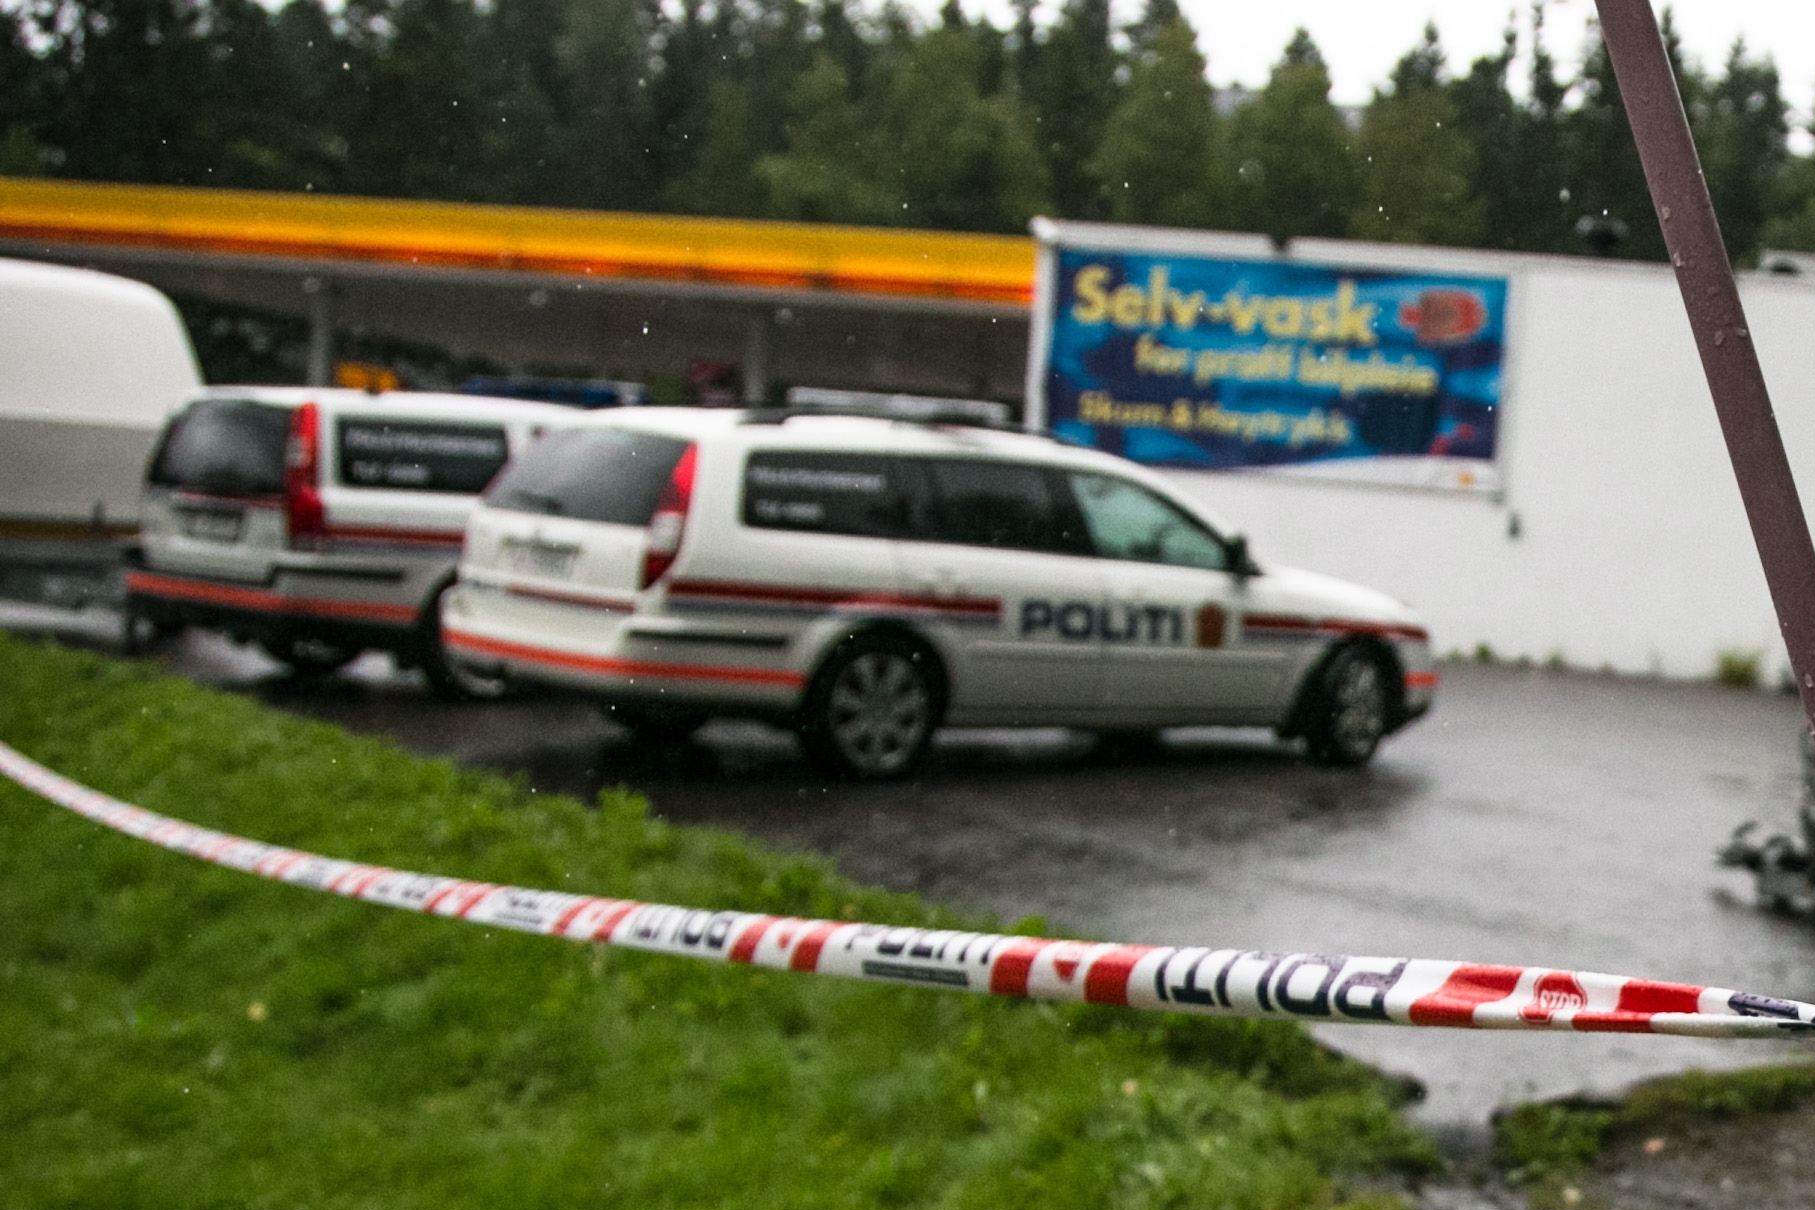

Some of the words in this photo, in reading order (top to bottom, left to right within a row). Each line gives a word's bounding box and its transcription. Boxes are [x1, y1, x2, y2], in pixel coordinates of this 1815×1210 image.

[1073, 264, 1377, 344] Selv-vask
[1135, 333, 1186, 373] for
[1021, 599, 1182, 642] POLITI
[1154, 949, 1410, 1021] POLITI
